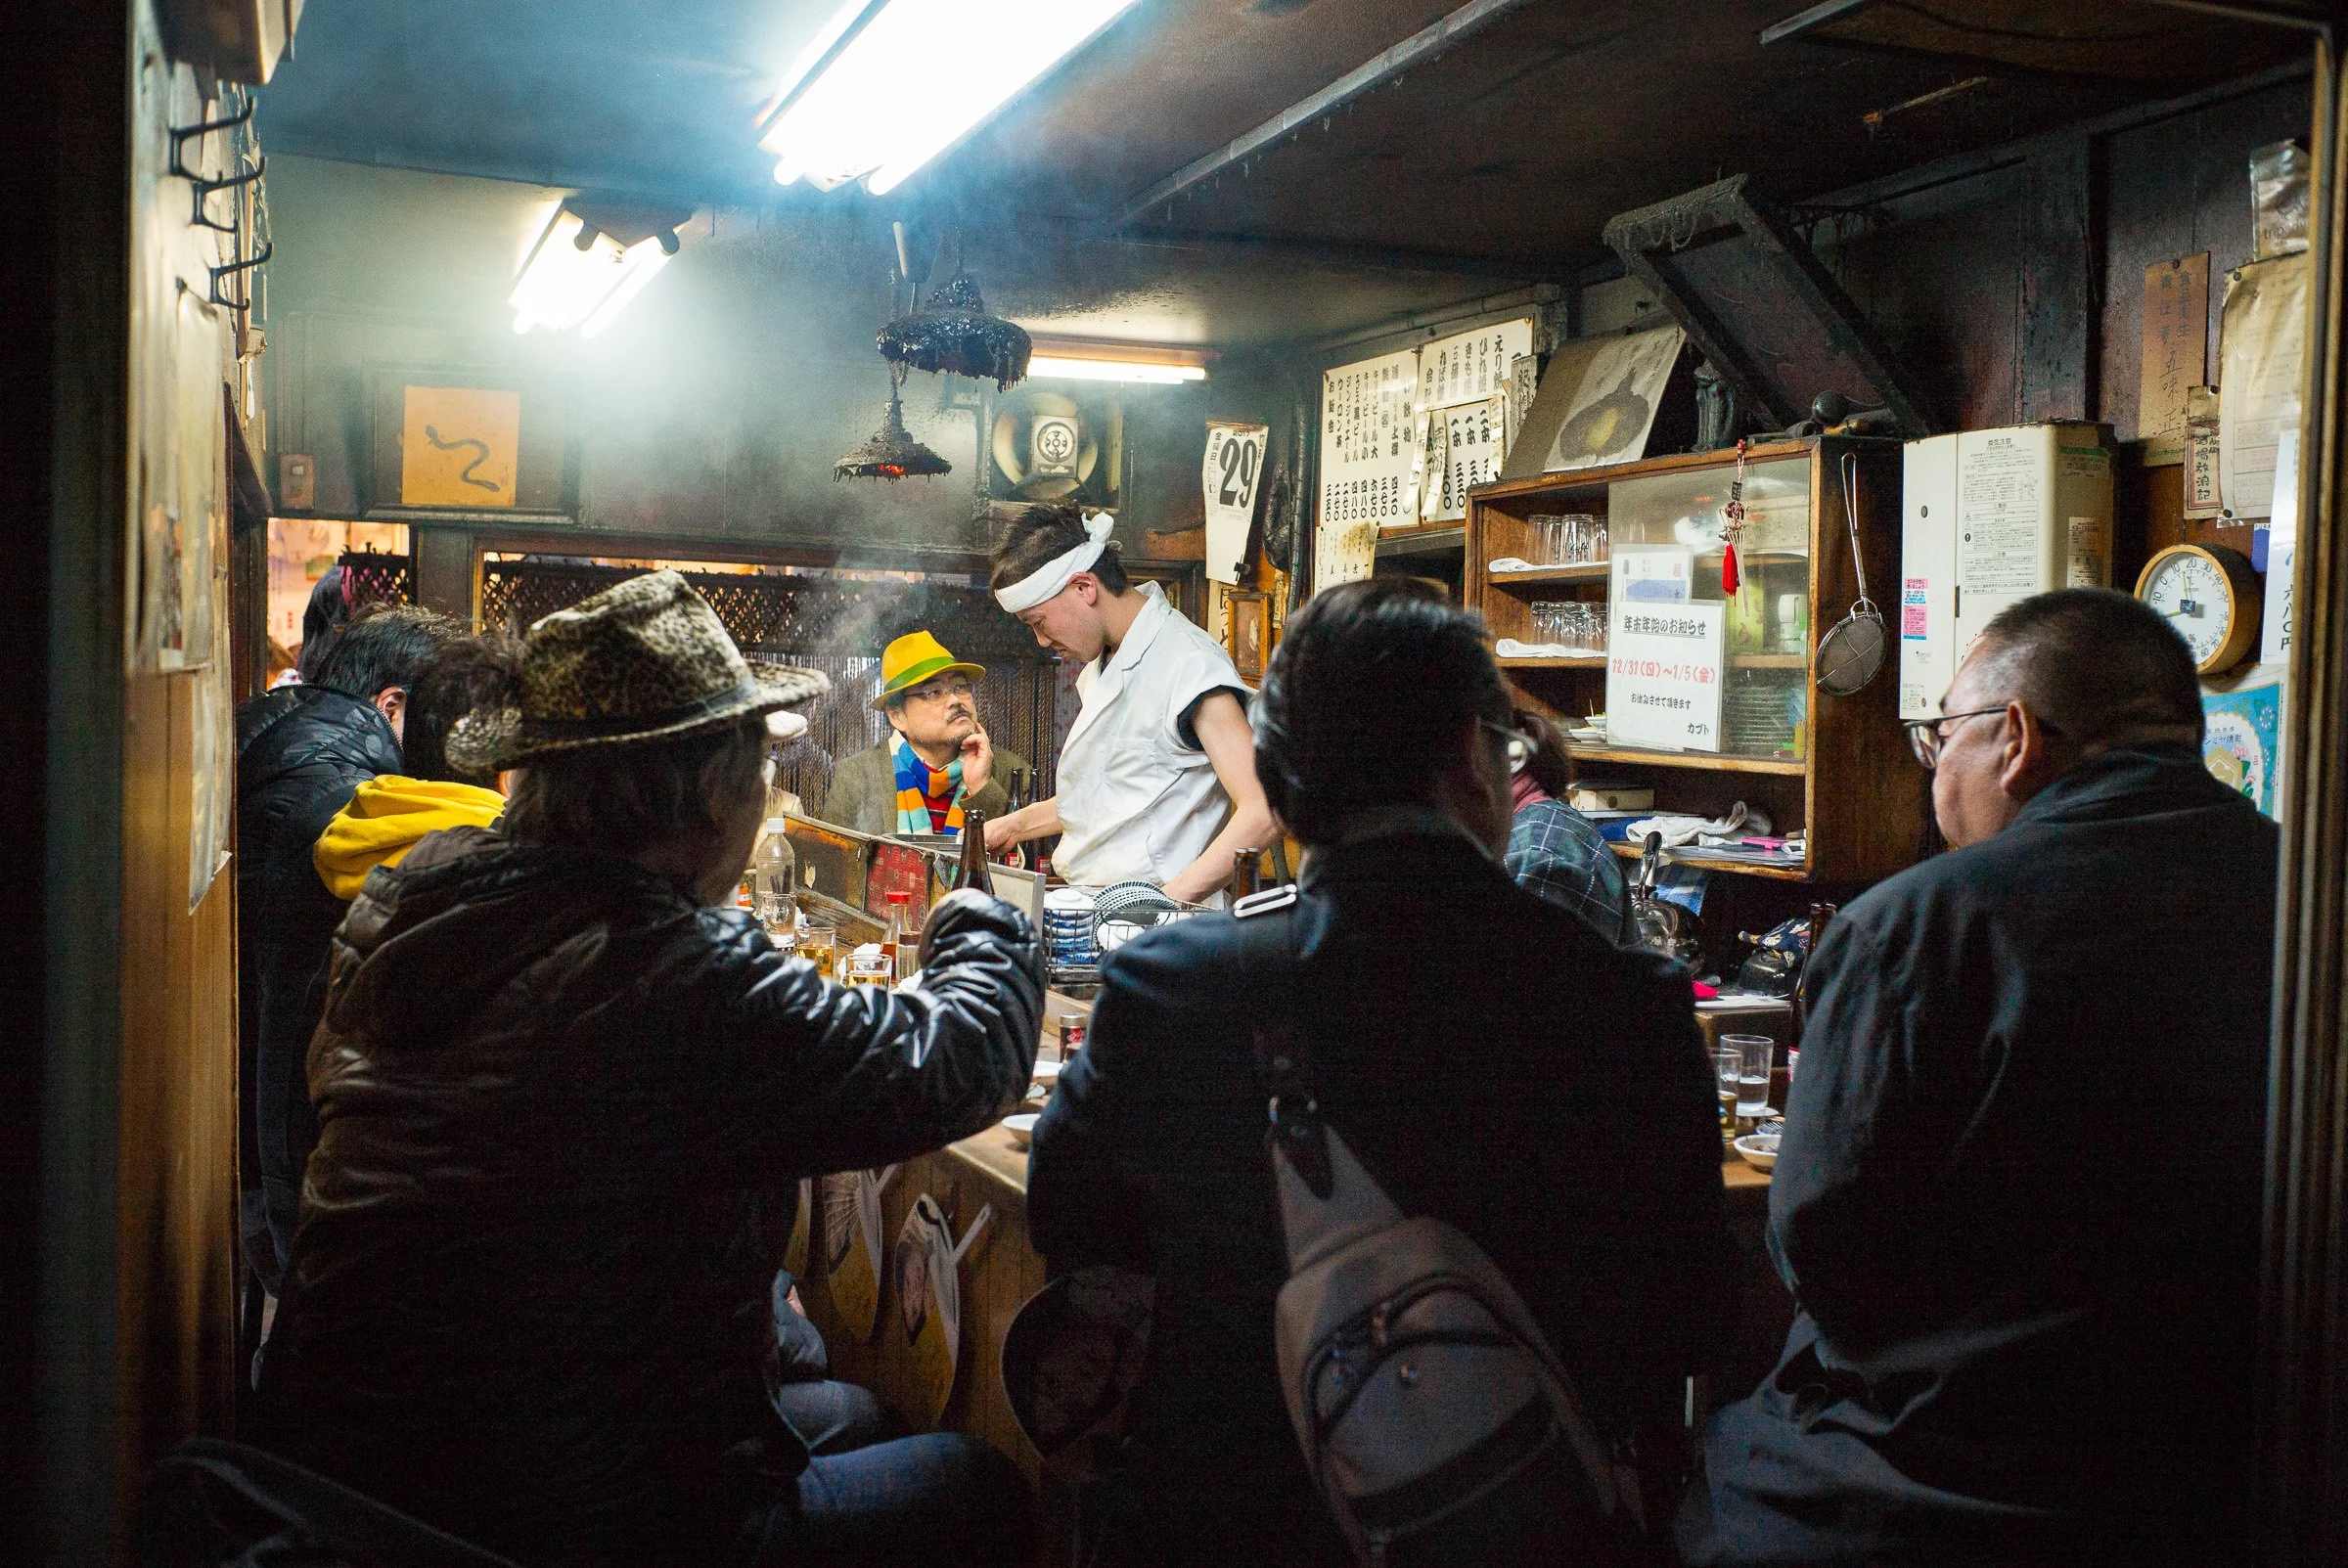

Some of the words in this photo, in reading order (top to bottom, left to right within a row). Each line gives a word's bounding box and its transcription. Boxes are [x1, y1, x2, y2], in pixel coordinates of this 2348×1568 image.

[1219, 438, 1257, 508] 29
[1624, 615, 1706, 636] 年末年始のお知らせ
[1631, 693, 1692, 710] お休みさせて頂きます
[1688, 723, 1710, 736] カブト
